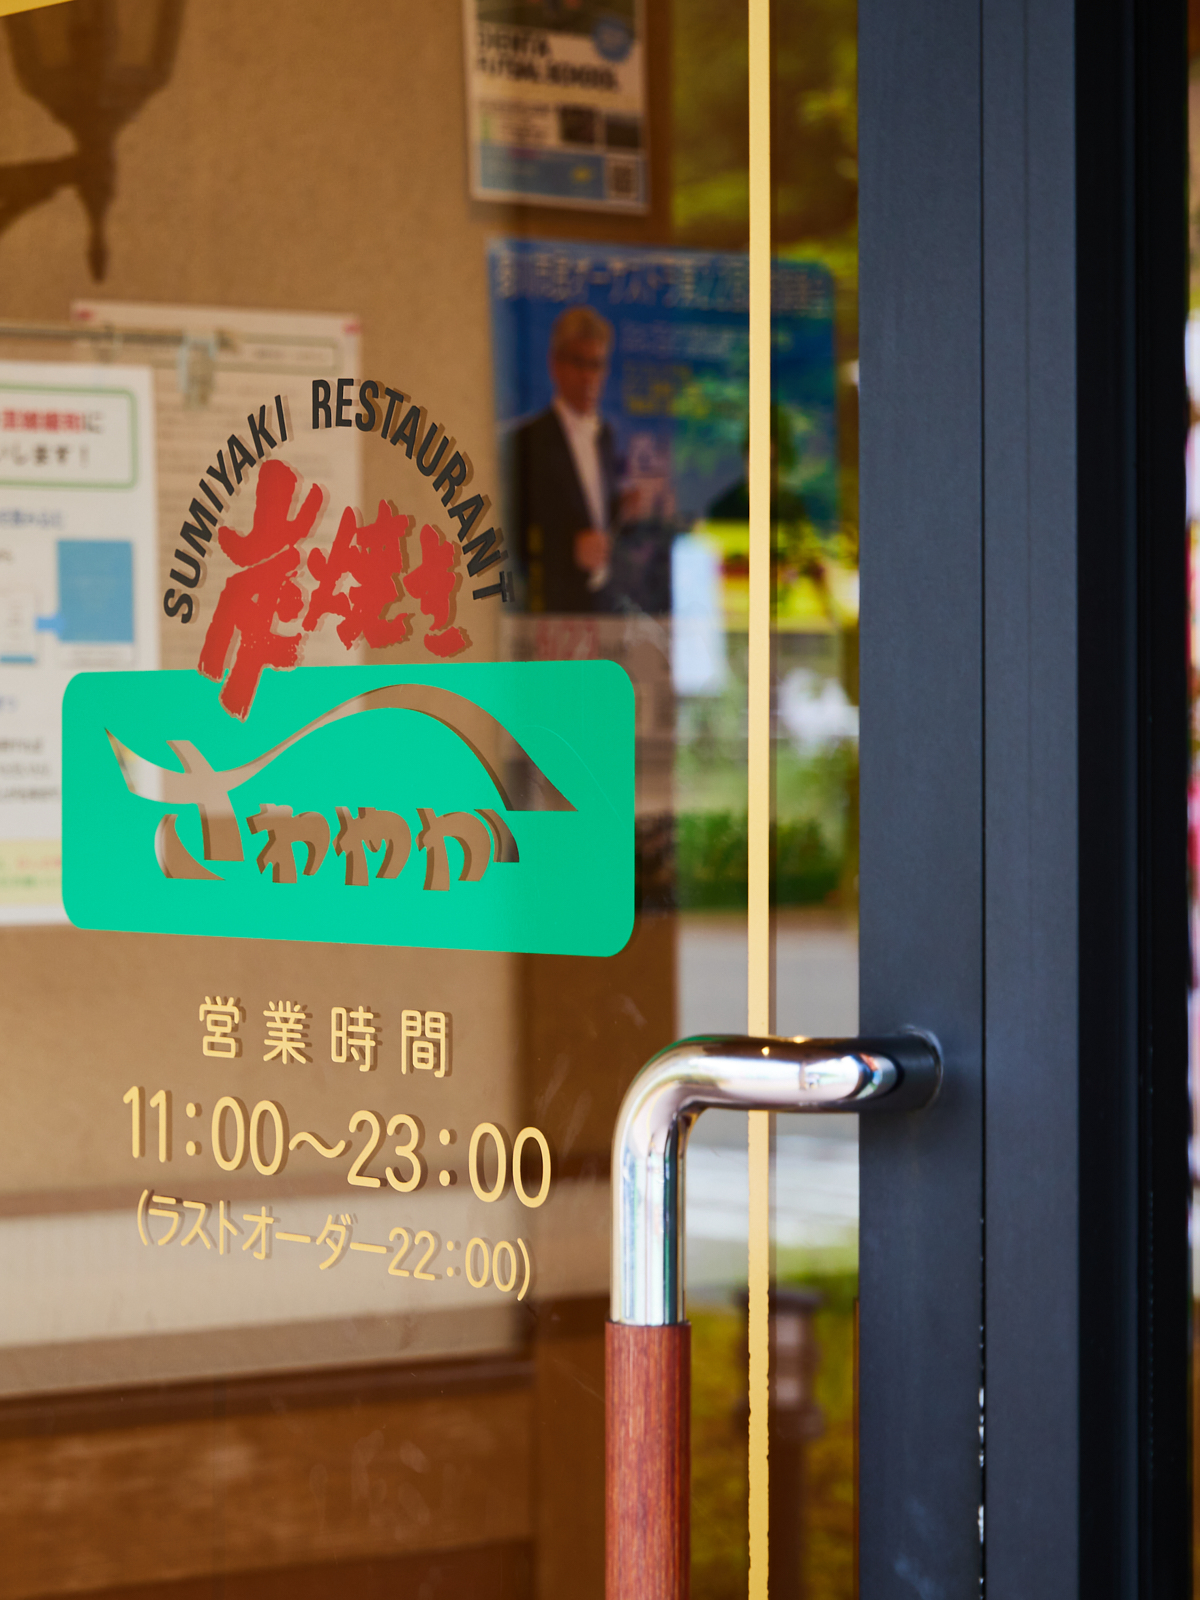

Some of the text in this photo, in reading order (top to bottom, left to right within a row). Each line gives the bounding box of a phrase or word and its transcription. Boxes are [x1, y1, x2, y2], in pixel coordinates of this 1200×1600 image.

[163, 378, 508, 624] SUMIYAKI RESTAURANT
[104, 683, 579, 891] さわやか
[198, 995, 447, 1078] 営業時間
